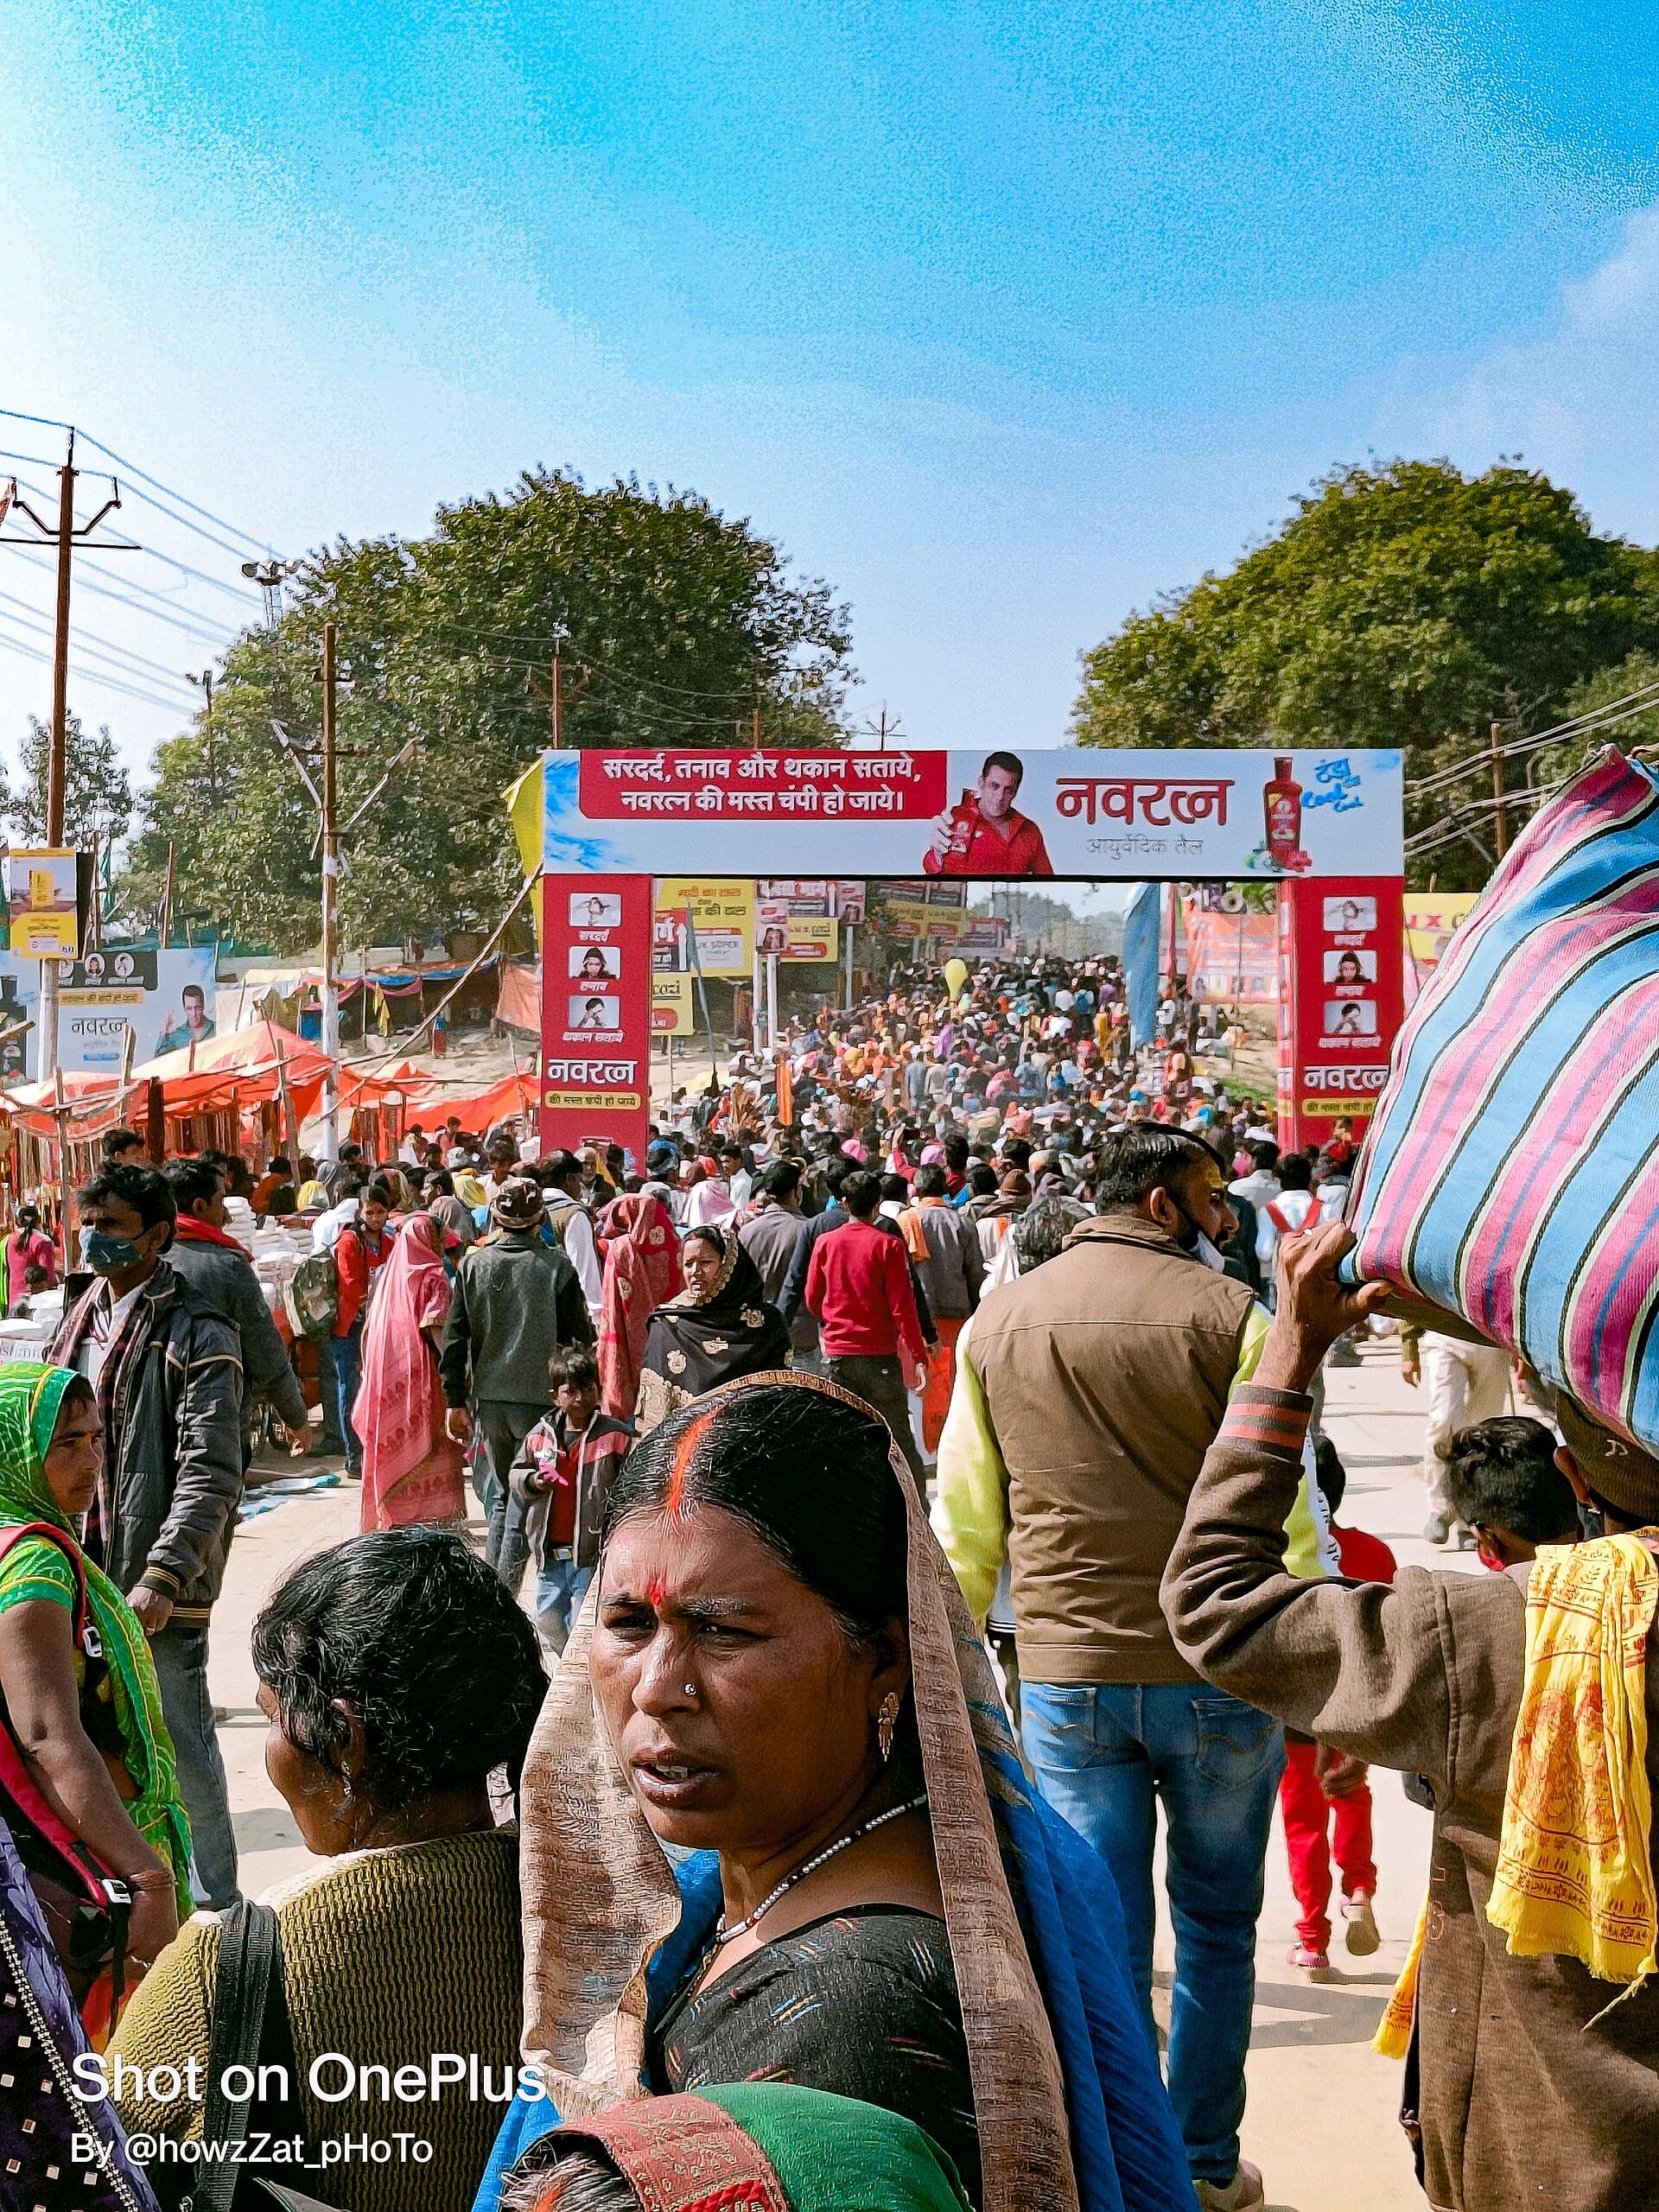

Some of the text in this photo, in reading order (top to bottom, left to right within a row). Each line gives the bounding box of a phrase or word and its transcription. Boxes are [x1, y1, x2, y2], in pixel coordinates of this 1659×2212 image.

[602, 752, 921, 783] सरदर्द, तनाव और थकान सताये,
[620, 791, 693, 812] नवरत्न
[694, 784, 726, 812] की
[727, 791, 775, 812] मस्त
[778, 784, 820, 811] चंपी
[821, 784, 847, 815] हो
[1056, 778, 1235, 826] नवरत्न
[547, 1058, 639, 1085] नवरत्न
